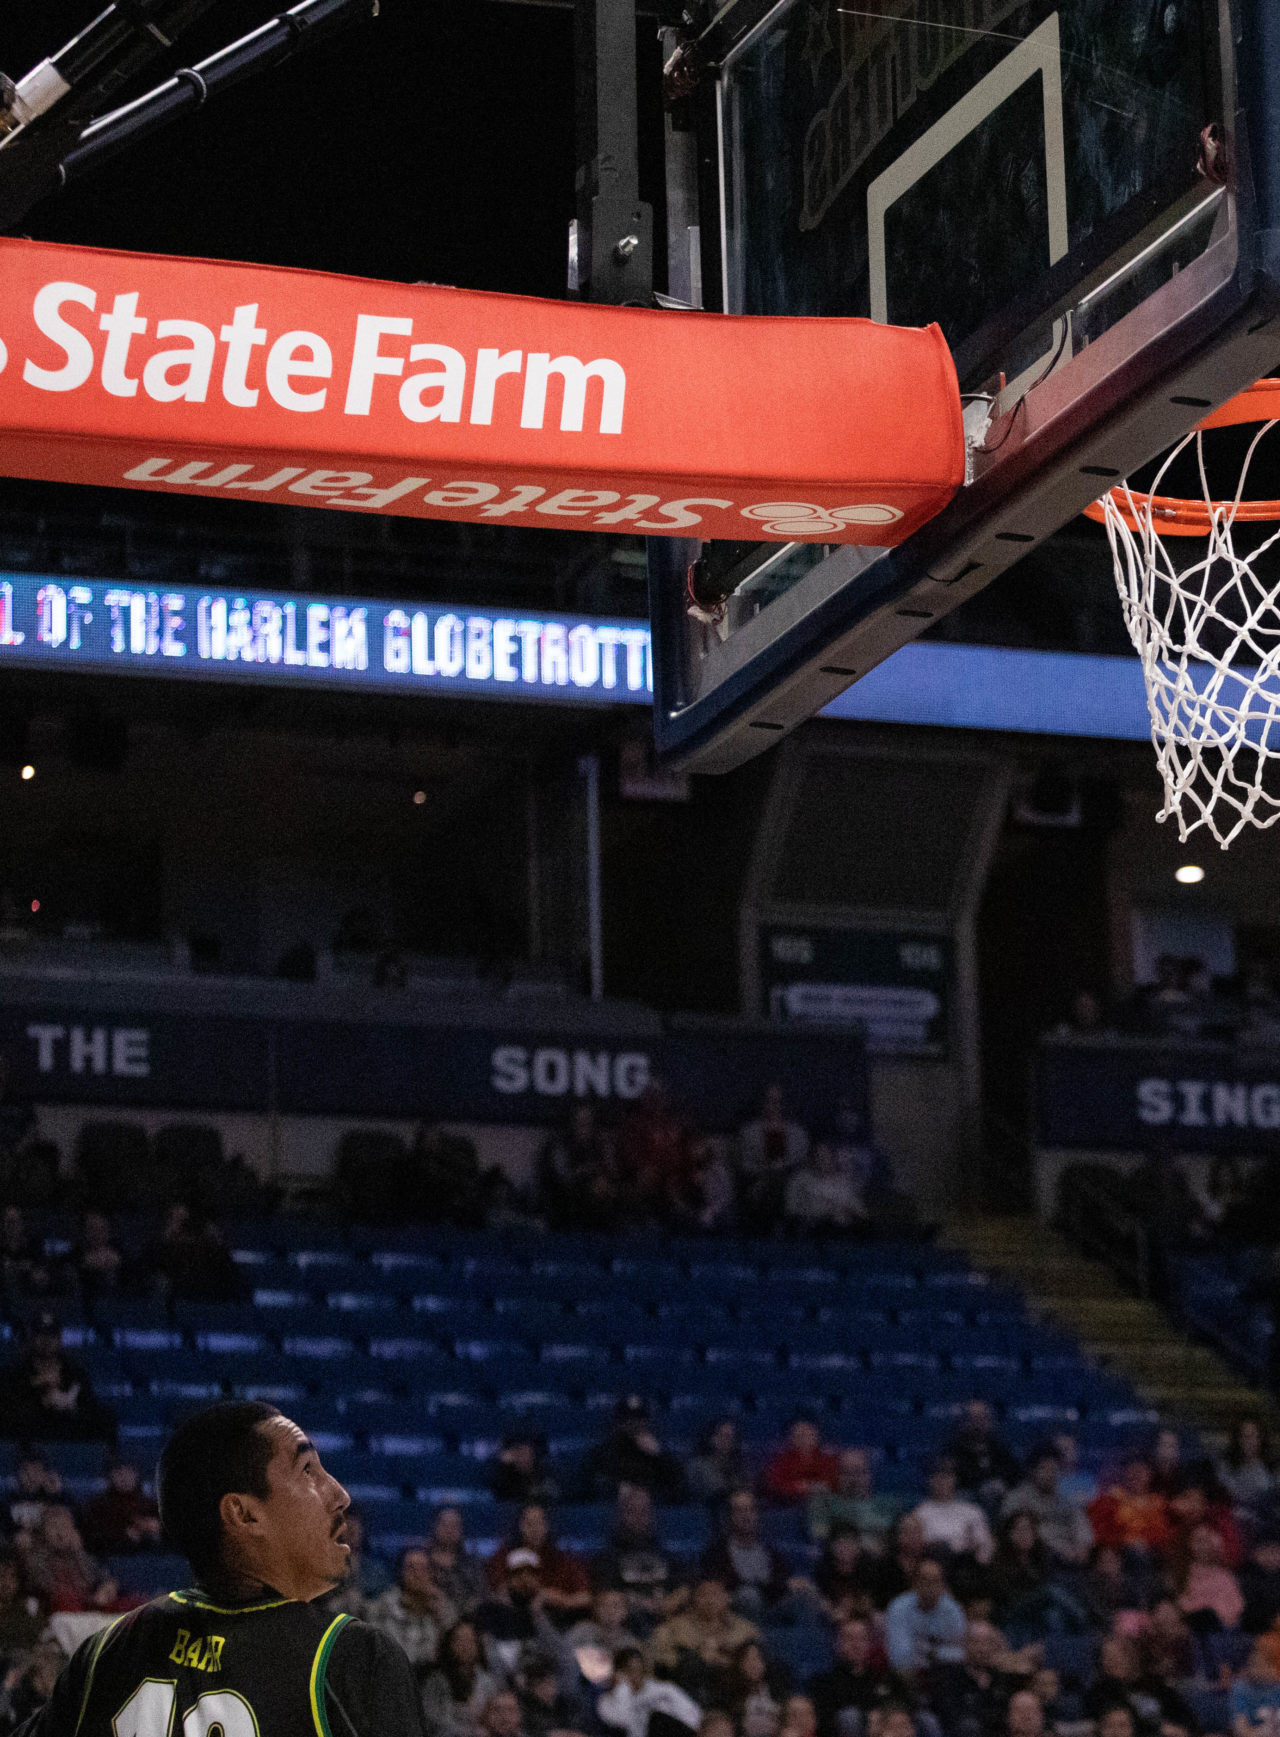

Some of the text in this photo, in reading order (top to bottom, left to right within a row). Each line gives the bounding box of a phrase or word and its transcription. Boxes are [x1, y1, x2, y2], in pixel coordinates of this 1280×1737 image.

[36, 584, 93, 650] OF
[104, 588, 187, 657] THE
[197, 595, 368, 670] HARLEM
[383, 609, 654, 693] GLOBETROTT
[27, 1024, 151, 1078] THE
[491, 1046, 652, 1100] SONG
